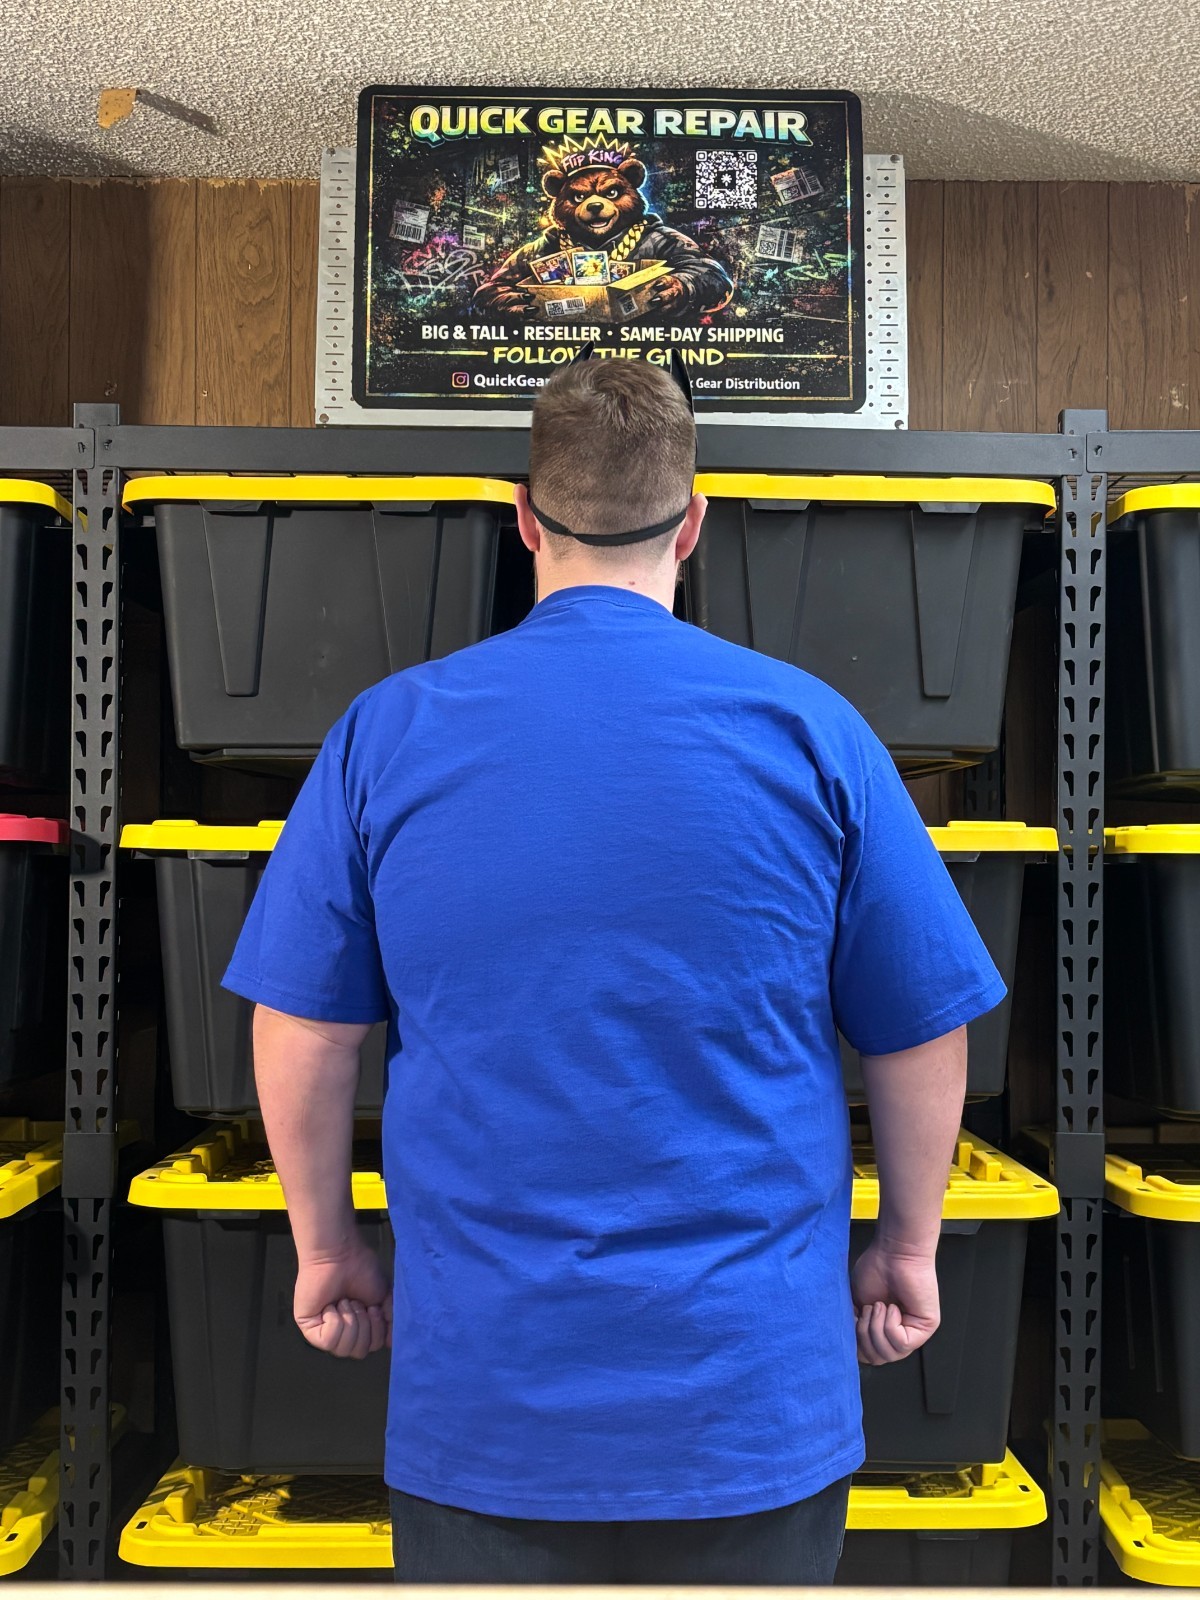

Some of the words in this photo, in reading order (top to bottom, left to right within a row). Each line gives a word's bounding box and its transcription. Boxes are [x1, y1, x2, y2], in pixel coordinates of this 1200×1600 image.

[410, 105, 532, 144] QUICK
[538, 107, 645, 135] GEAR
[654, 108, 809, 143] REPAIR
[421, 325, 449, 340] BIG
[452, 325, 467, 340] &
[470, 326, 509, 340] TALL
[524, 326, 602, 341] RESELLER
[620, 327, 703, 342] SAME-DAY
[707, 328, 784, 343] SHIPPING
[593, 348, 641, 360] THE
[696, 378, 723, 389] Gear
[725, 378, 800, 390] Distribution
